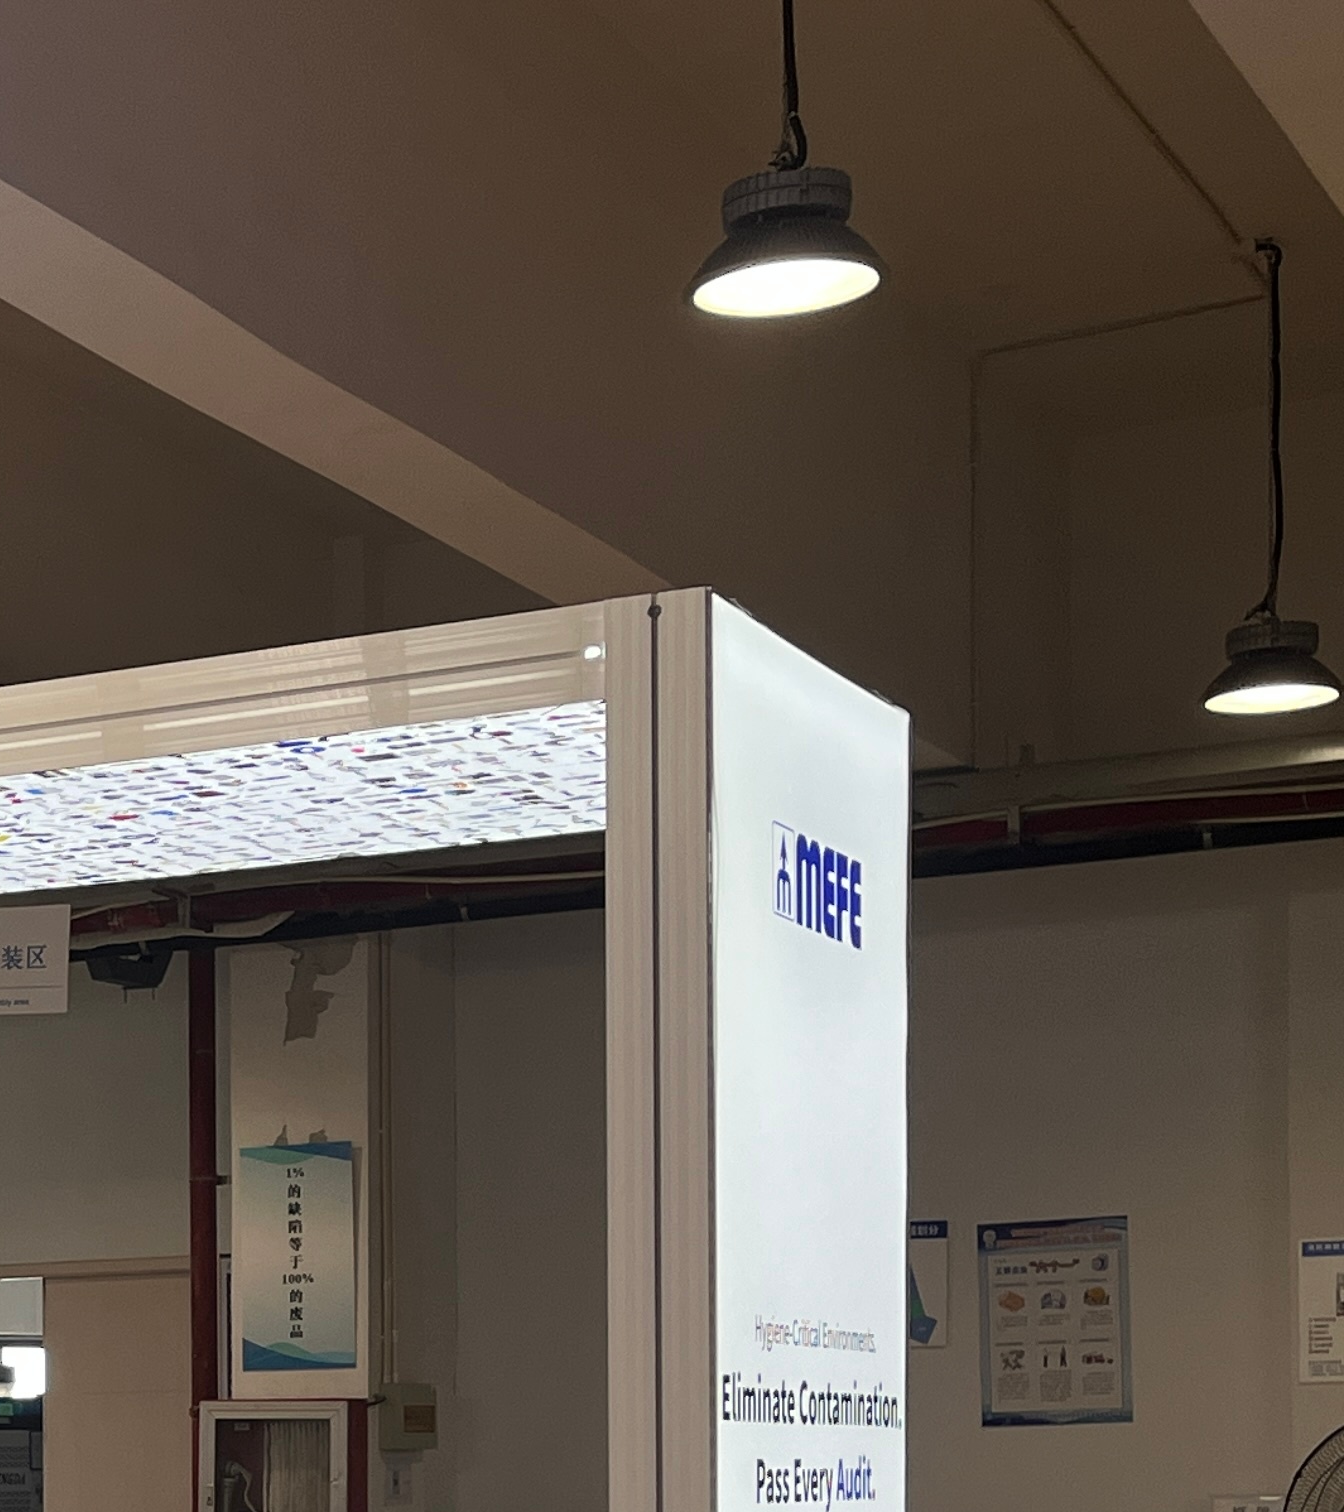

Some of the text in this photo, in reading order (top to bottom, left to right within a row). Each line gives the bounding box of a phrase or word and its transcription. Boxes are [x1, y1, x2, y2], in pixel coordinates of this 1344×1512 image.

[797, 833, 862, 951] MEFE
[722, 1372, 902, 1430] Eliminate Contamination.
[756, 1455, 876, 1512] Pass Every Audit.
